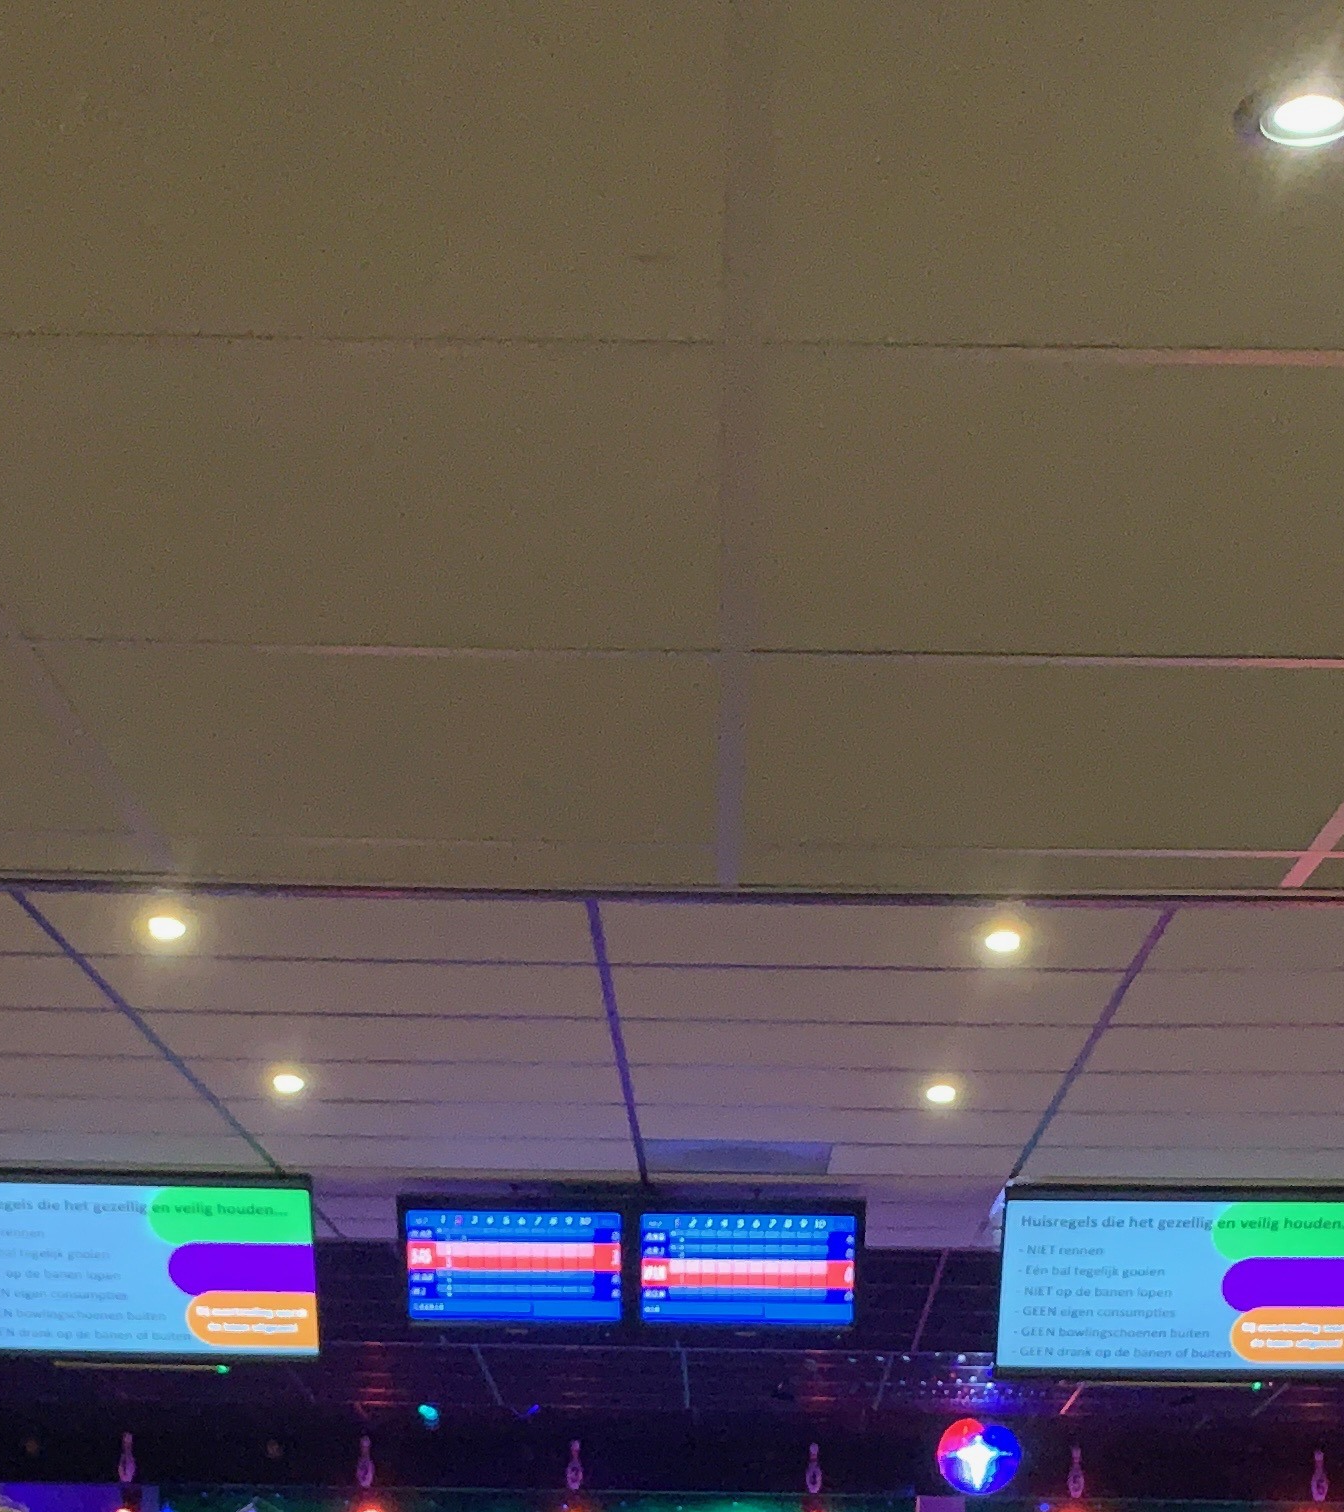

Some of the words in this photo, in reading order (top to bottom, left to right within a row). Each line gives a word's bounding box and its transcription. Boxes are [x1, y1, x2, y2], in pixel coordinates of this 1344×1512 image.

[37, 1199, 61, 1211] die
[64, 1200, 89, 1212] het
[152, 1204, 170, 1213] en
[174, 1202, 213, 1216] veilig
[1021, 1215, 1098, 1230] Huisregels
[1102, 1216, 1125, 1228] die
[1128, 1216, 1153, 1228] het
[1157, 1216, 1213, 1231] gezellig
[1217, 1219, 1236, 1229] en
[1240, 1217, 1279, 1231] veilig
[1027, 1245, 1055, 1255] NIET
[1052, 1265, 1070, 1276] bal
[1074, 1266, 1119, 1278] tegelijk
[1024, 1286, 1053, 1296] NIET
[1056, 1288, 1072, 1298] op
[1075, 1287, 1091, 1296] de
[1094, 1287, 1133, 1297] banen
[1022, 1306, 1057, 1316] GEEN
[1060, 1307, 1094, 1318] eigen
[1097, 1307, 1176, 1318] consumpties
[1021, 1326, 1055, 1337] GEEN
[1058, 1327, 1167, 1339] bowlingschoenen
[1170, 1328, 1209, 1338] buiten
[1019, 1346, 1054, 1357] GEEN
[1057, 1347, 1093, 1357] drank
[1095, 1349, 1111, 1359] op
[1114, 1348, 1130, 1357] de
[1133, 1348, 1172, 1358] banen
[1175, 1348, 1188, 1358] of
[1190, 1349, 1231, 1359] buiten
